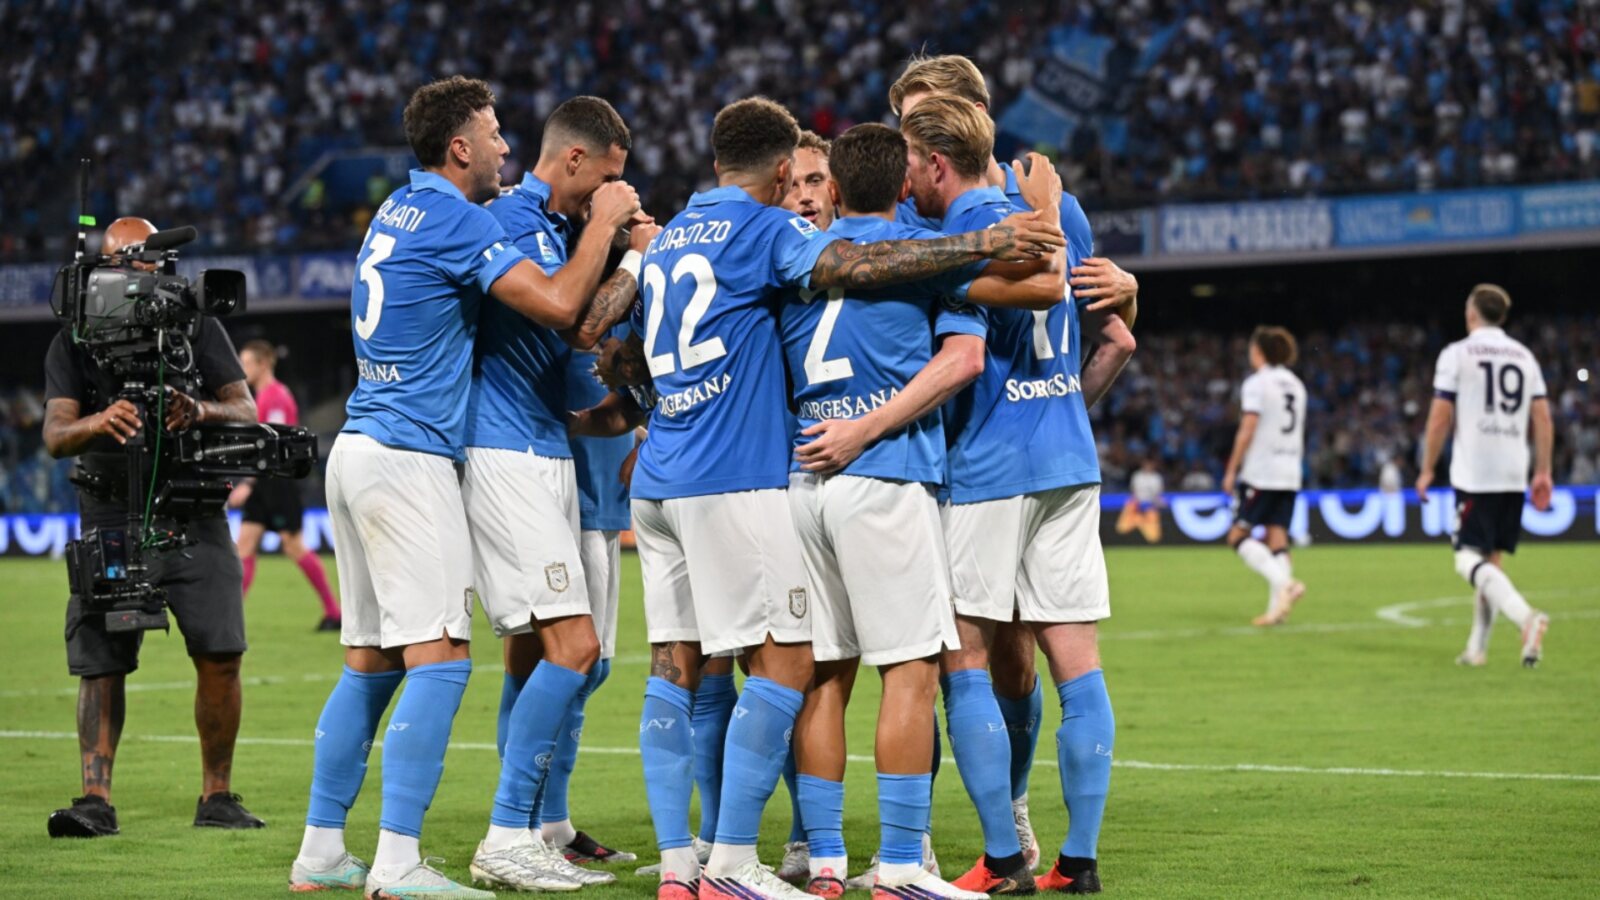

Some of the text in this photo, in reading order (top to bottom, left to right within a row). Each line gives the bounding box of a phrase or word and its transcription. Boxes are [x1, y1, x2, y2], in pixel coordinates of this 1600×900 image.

[643, 253, 728, 379] 22
[1281, 393, 1297, 435] 3
[1478, 361, 1524, 415] 19
